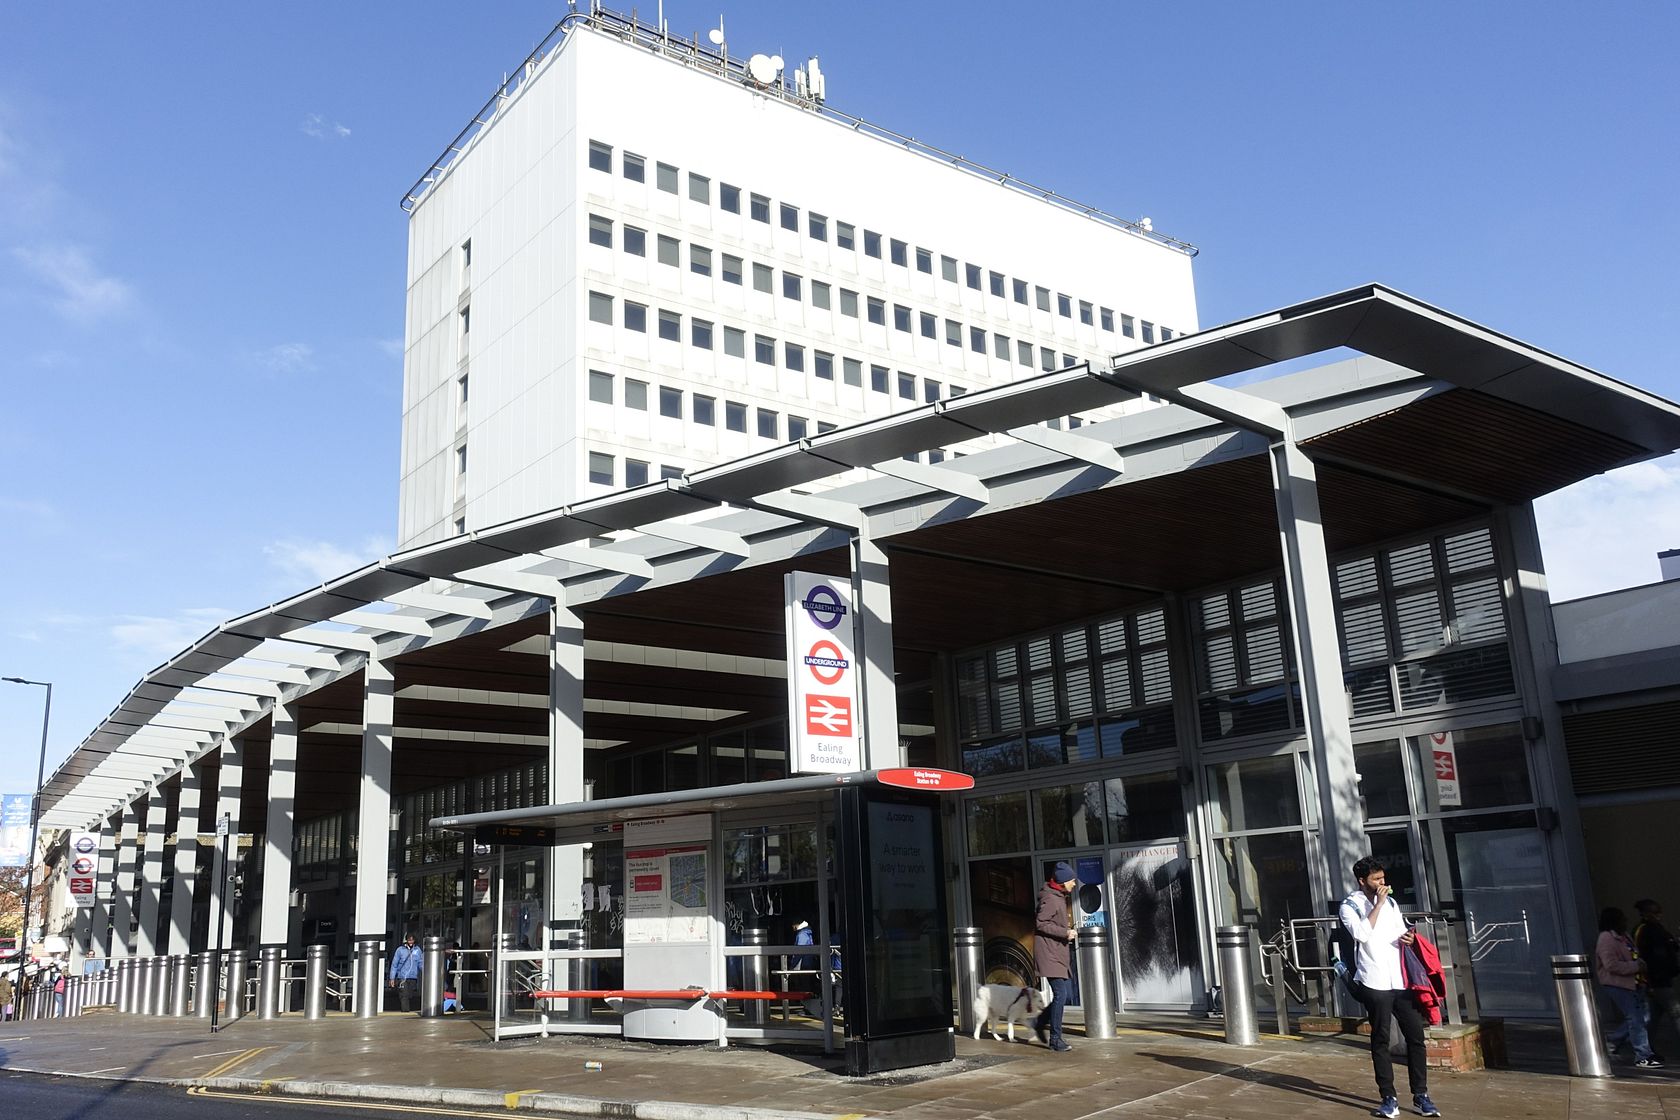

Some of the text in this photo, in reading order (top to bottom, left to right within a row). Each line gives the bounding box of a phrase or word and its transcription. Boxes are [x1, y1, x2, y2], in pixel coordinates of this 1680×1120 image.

[803, 602, 832, 612] ELIZABETH
[806, 657, 847, 667] UNDERGROUND
[817, 742, 844, 755] Ealing
[810, 753, 852, 767] Broadway
[892, 845, 921, 857] smarter
[1120, 847, 1179, 859] PITZHANGER
